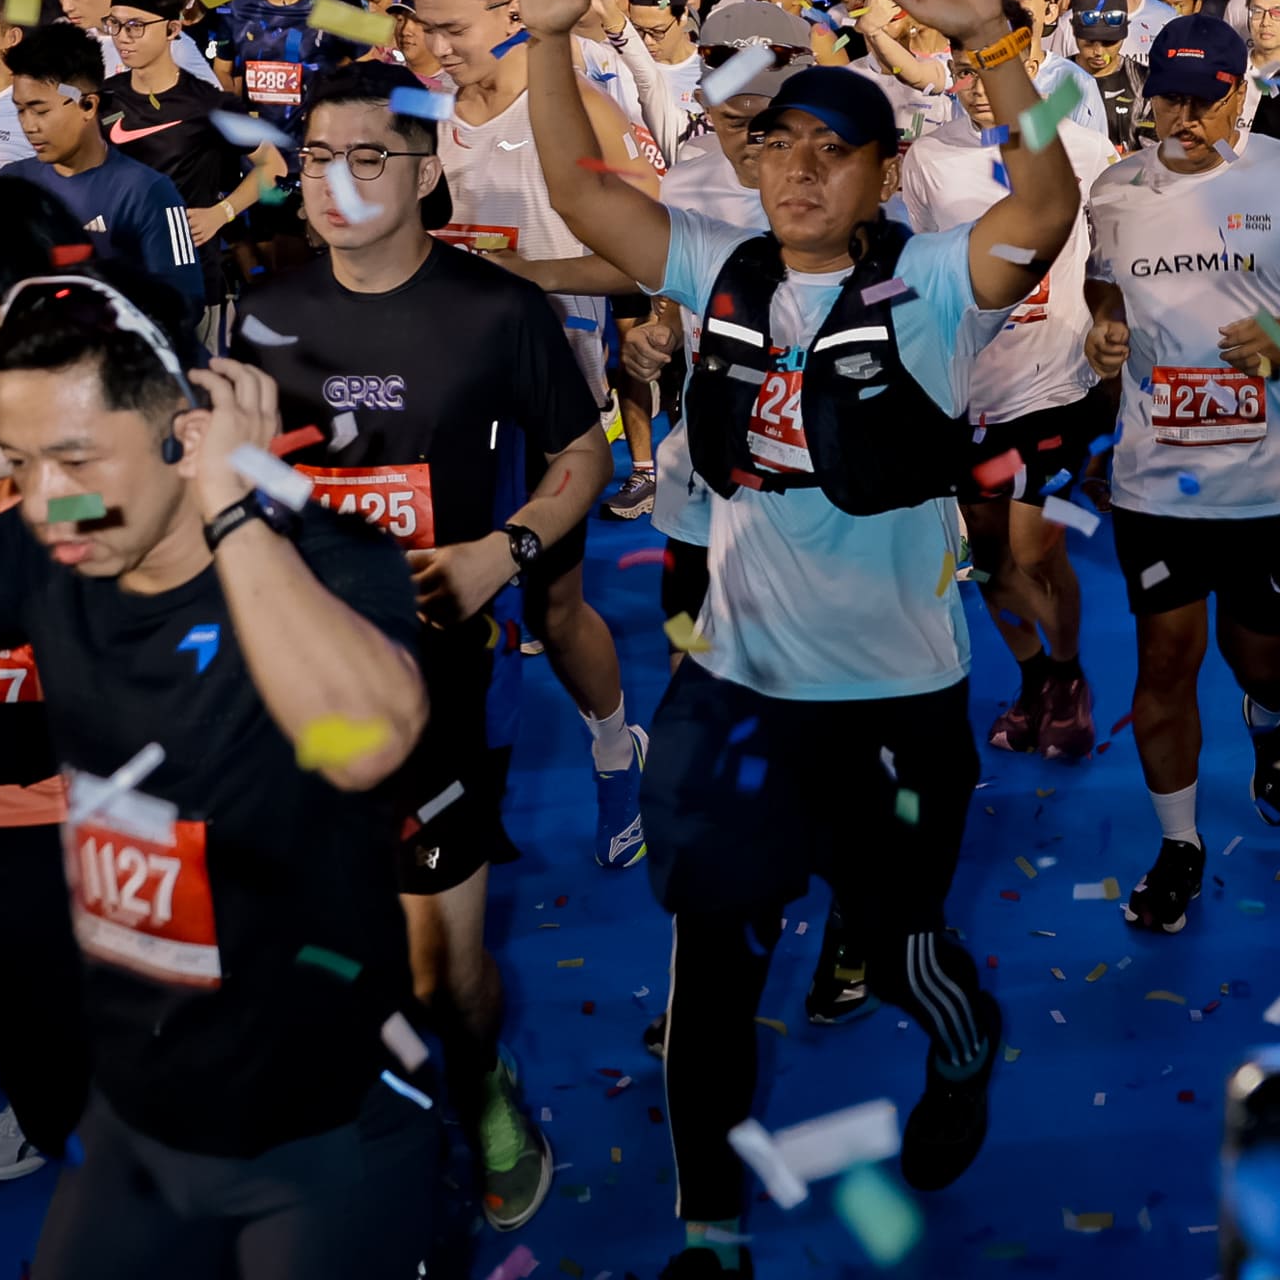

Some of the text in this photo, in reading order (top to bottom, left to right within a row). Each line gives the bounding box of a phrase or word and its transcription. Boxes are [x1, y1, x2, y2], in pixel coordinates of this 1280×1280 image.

[1245, 213, 1272, 223] bank
[1131, 252, 1255, 277] GARMIN
[323, 374, 407, 411] GPRC
[80, 835, 182, 926] 1127
